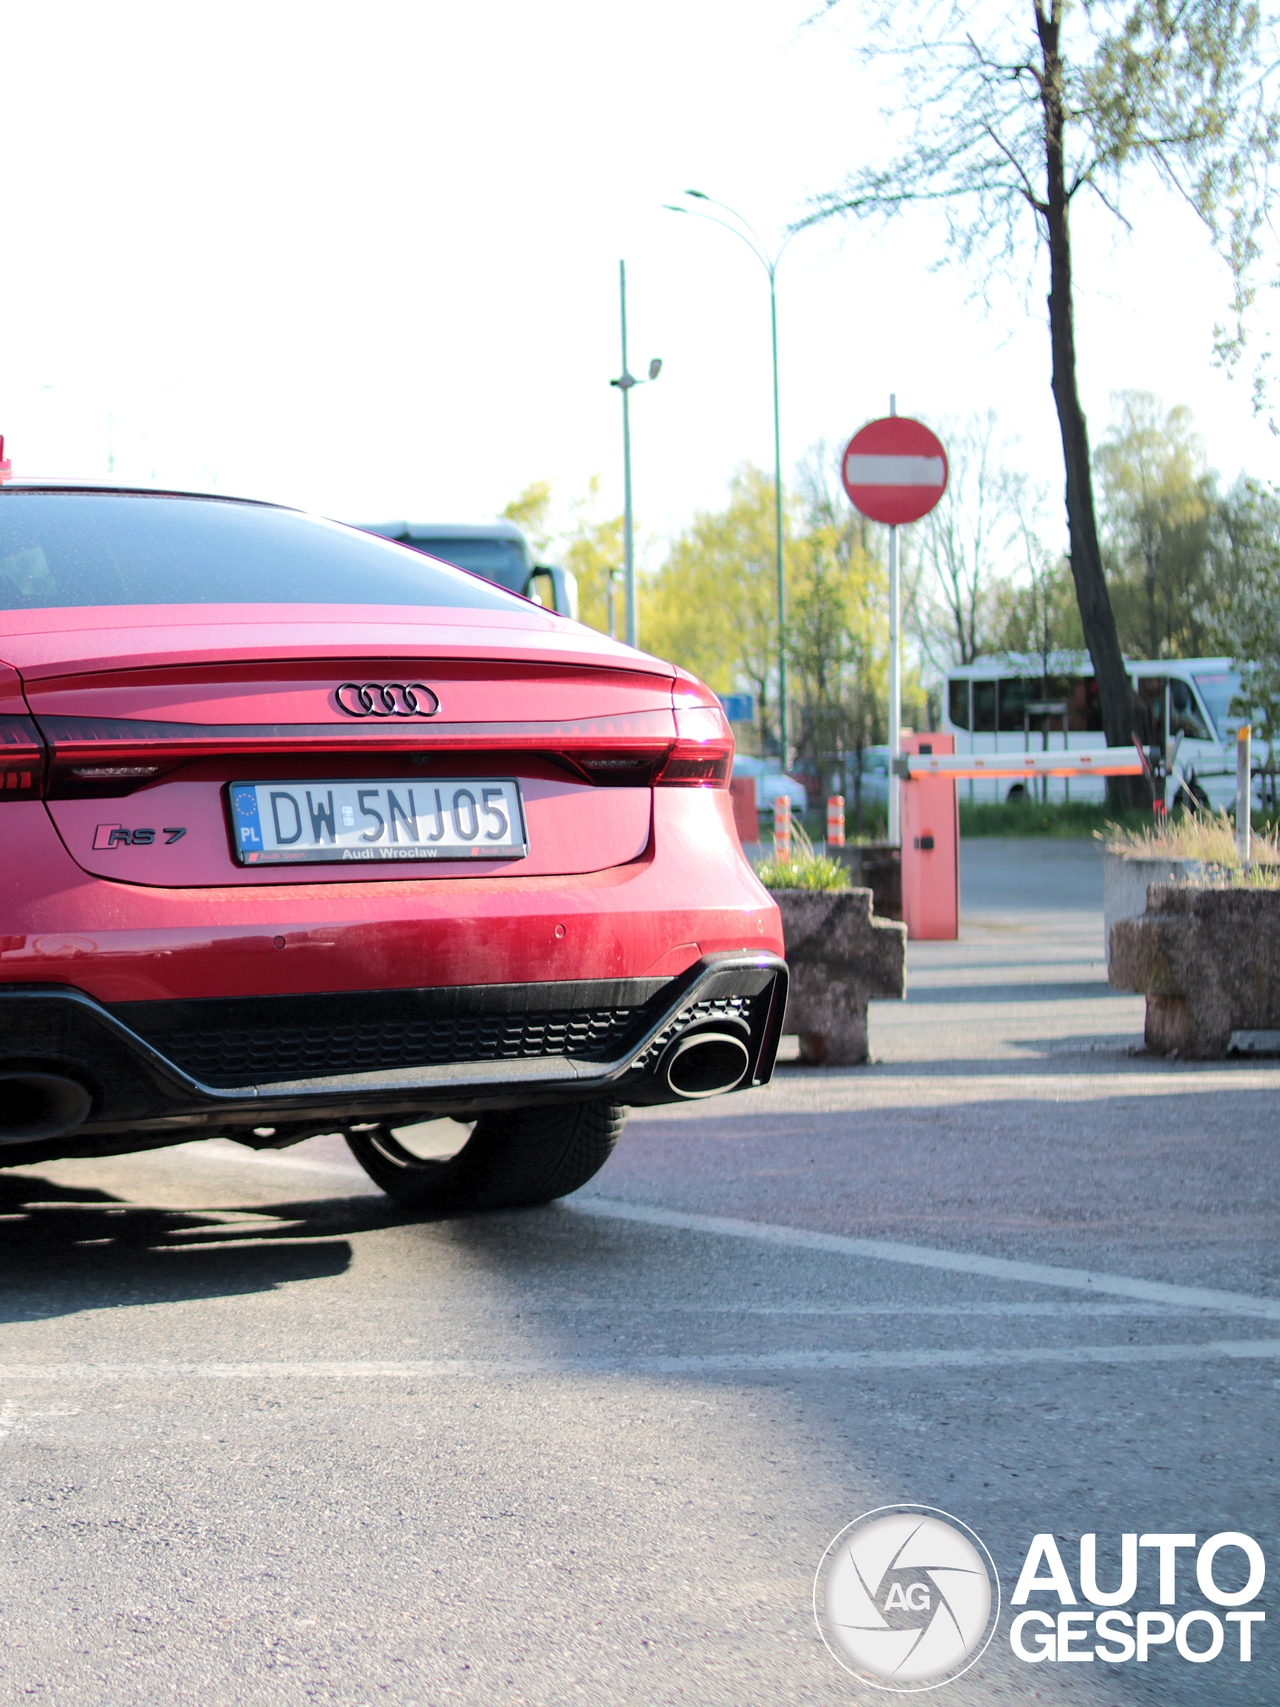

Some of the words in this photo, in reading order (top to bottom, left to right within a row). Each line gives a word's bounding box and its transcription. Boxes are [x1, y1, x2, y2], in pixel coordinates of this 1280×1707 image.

[269, 790, 336, 844] DW
[108, 828, 155, 845] RS
[163, 827, 187, 845] 7
[240, 826, 260, 842] PL
[282, 852, 306, 861] Sport
[341, 848, 374, 860] Audi
